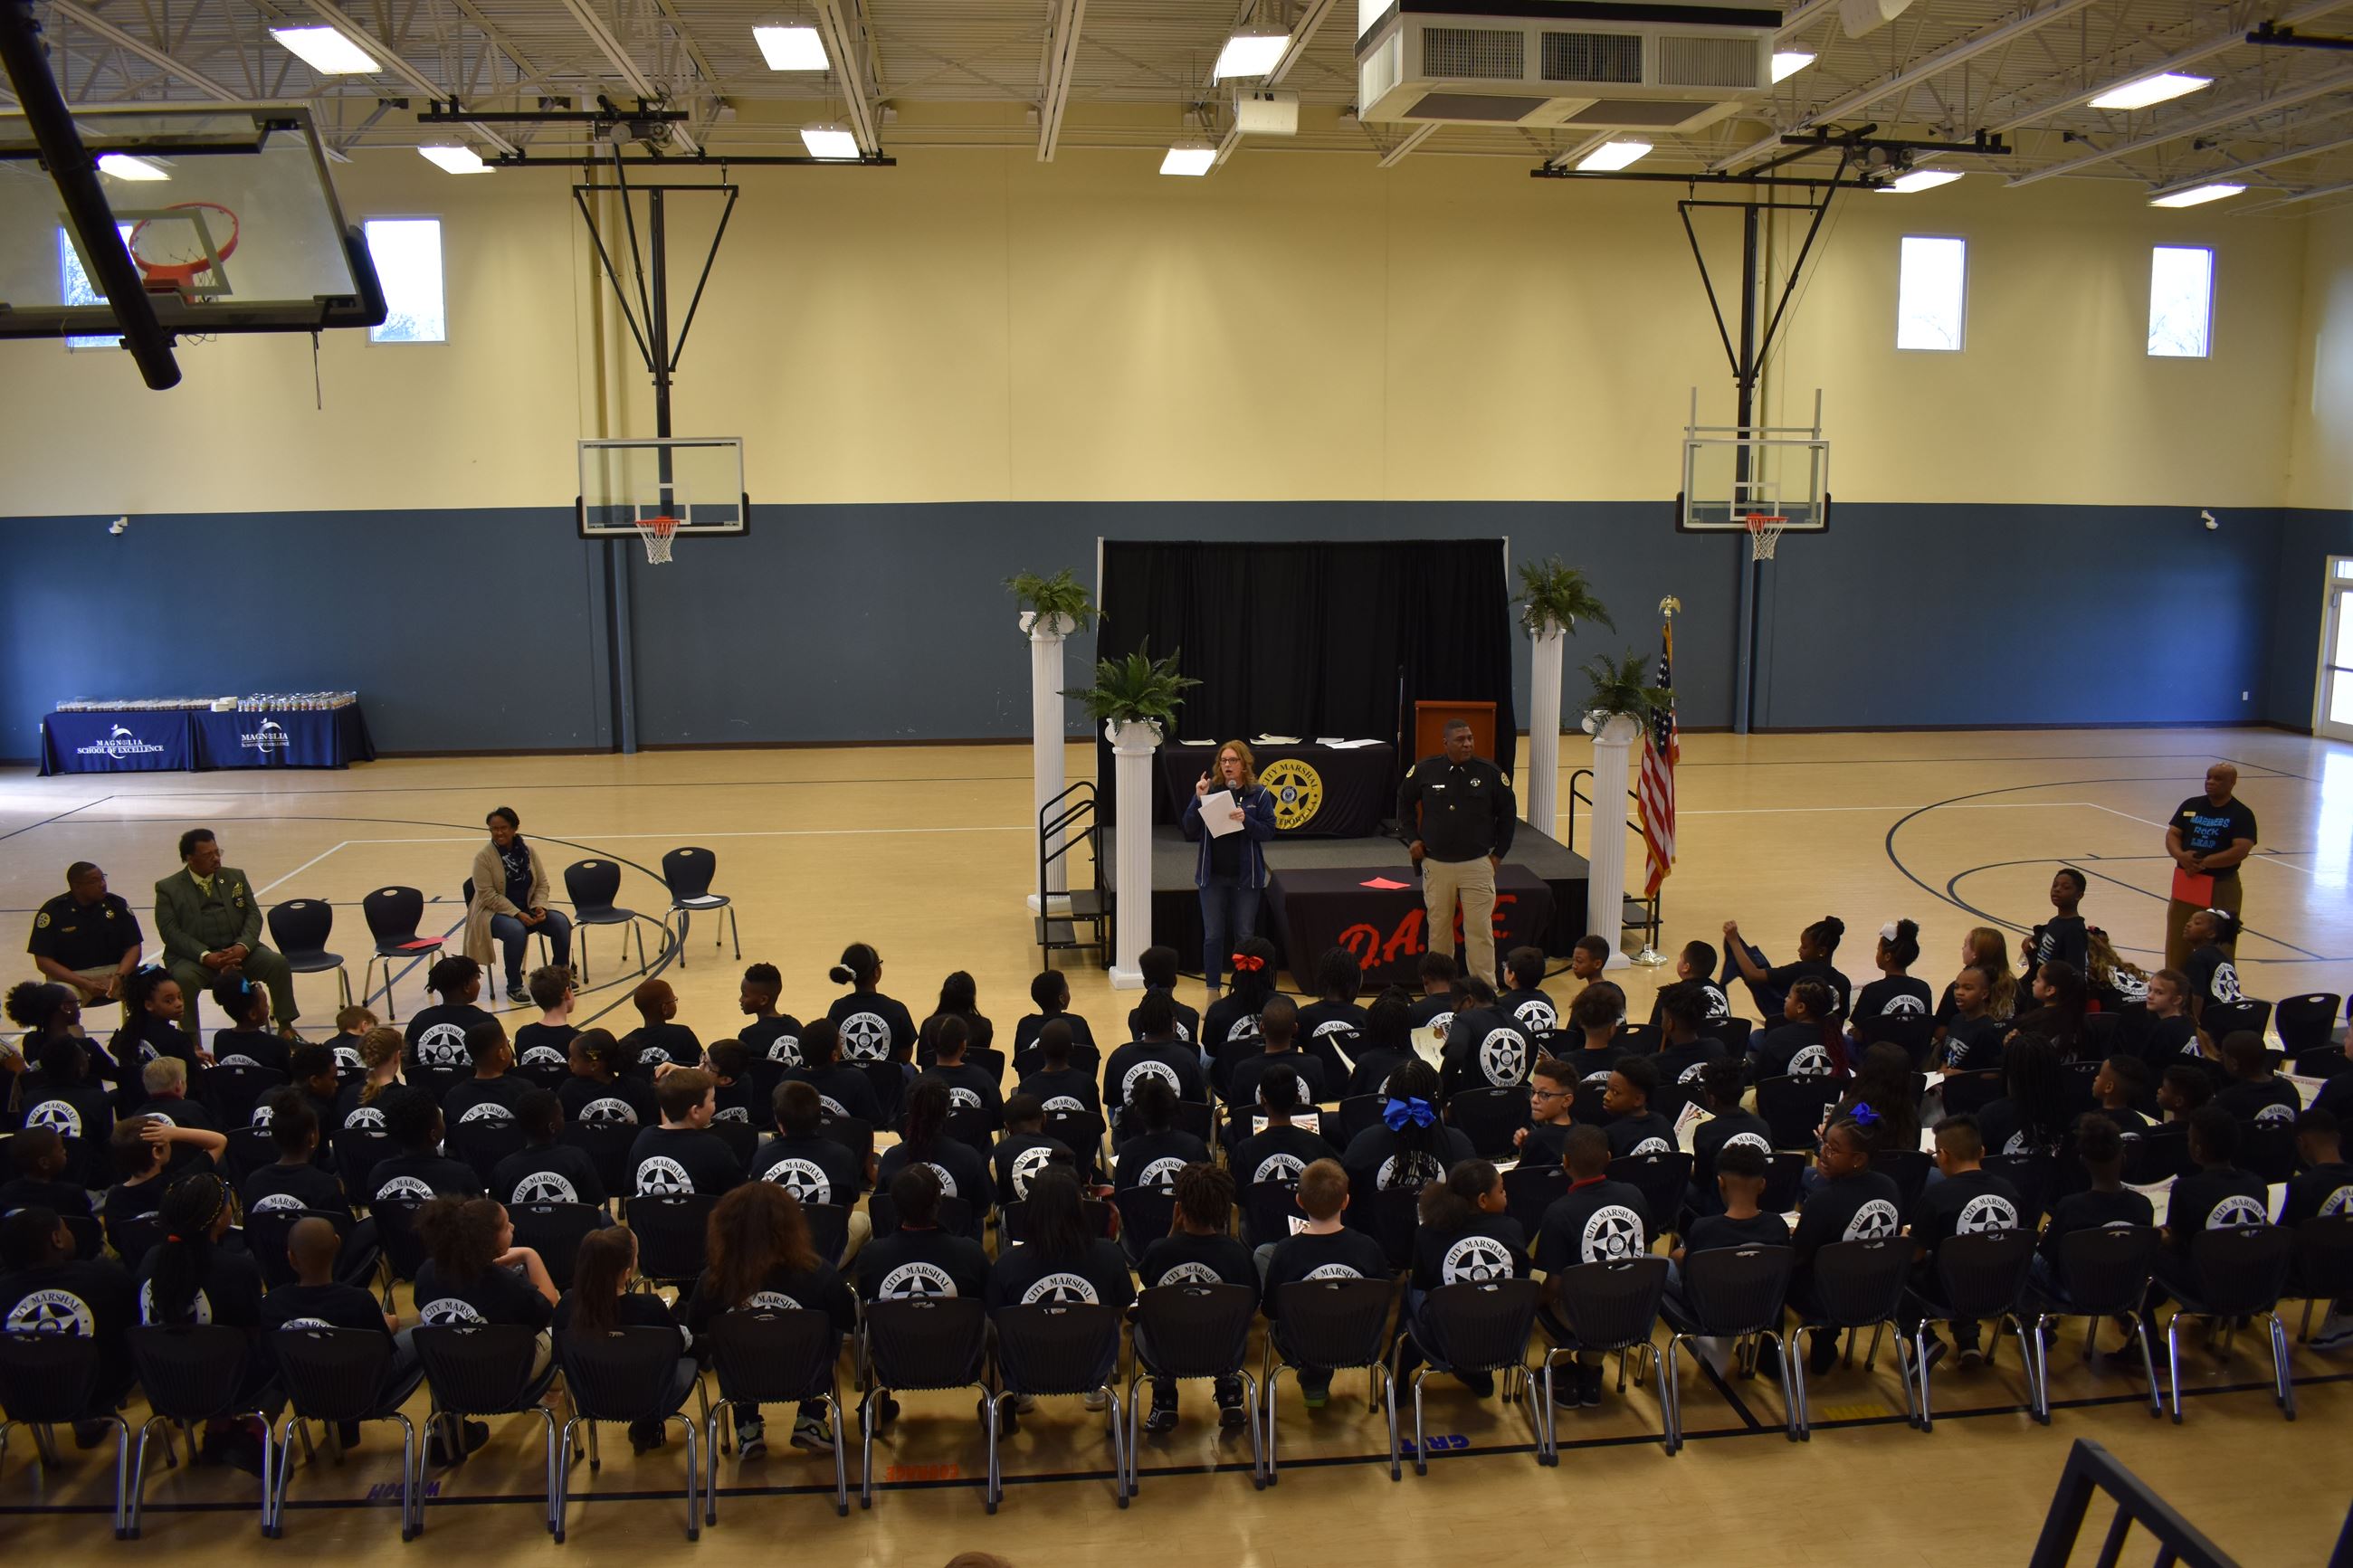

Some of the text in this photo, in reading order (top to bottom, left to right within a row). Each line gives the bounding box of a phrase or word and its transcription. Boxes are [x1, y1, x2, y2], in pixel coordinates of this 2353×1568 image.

[122, 746, 169, 754] EXCELLENCE
[1262, 763, 1319, 791] CITY MARSHAL
[843, 1014, 886, 1031] CITY MARSHAL
[422, 1031, 435, 1043] CITY
[1793, 1050, 1806, 1067] CITY
[1126, 1063, 1175, 1082] CITY MARSHAL
[43, 1102, 77, 1122] MARSHAL
[596, 1100, 629, 1116] MARSHAL
[653, 1158, 685, 1181] MARSHAL
[767, 1161, 824, 1183] CITY MARSHAL
[1141, 1171, 1154, 1185] CITY
[1257, 1156, 1303, 1179] CITY MARSHA
[515, 1174, 568, 1202] CITY MARSHAL
[1851, 1202, 1897, 1231] CITY MARSHAL
[1963, 1197, 2015, 1221] CITY MARSHAL
[2213, 1205, 2229, 1221] CITY
[1586, 1209, 1638, 1239] CITY MARSHAL
[1447, 1240, 1506, 1266] CITY MARSHAL
[884, 1265, 950, 1291] CITY MARSHAL
[1027, 1277, 1093, 1301] CITY MARSHAL
[31, 1292, 81, 1314] MARSHAL
[425, 1304, 440, 1318] CITY
